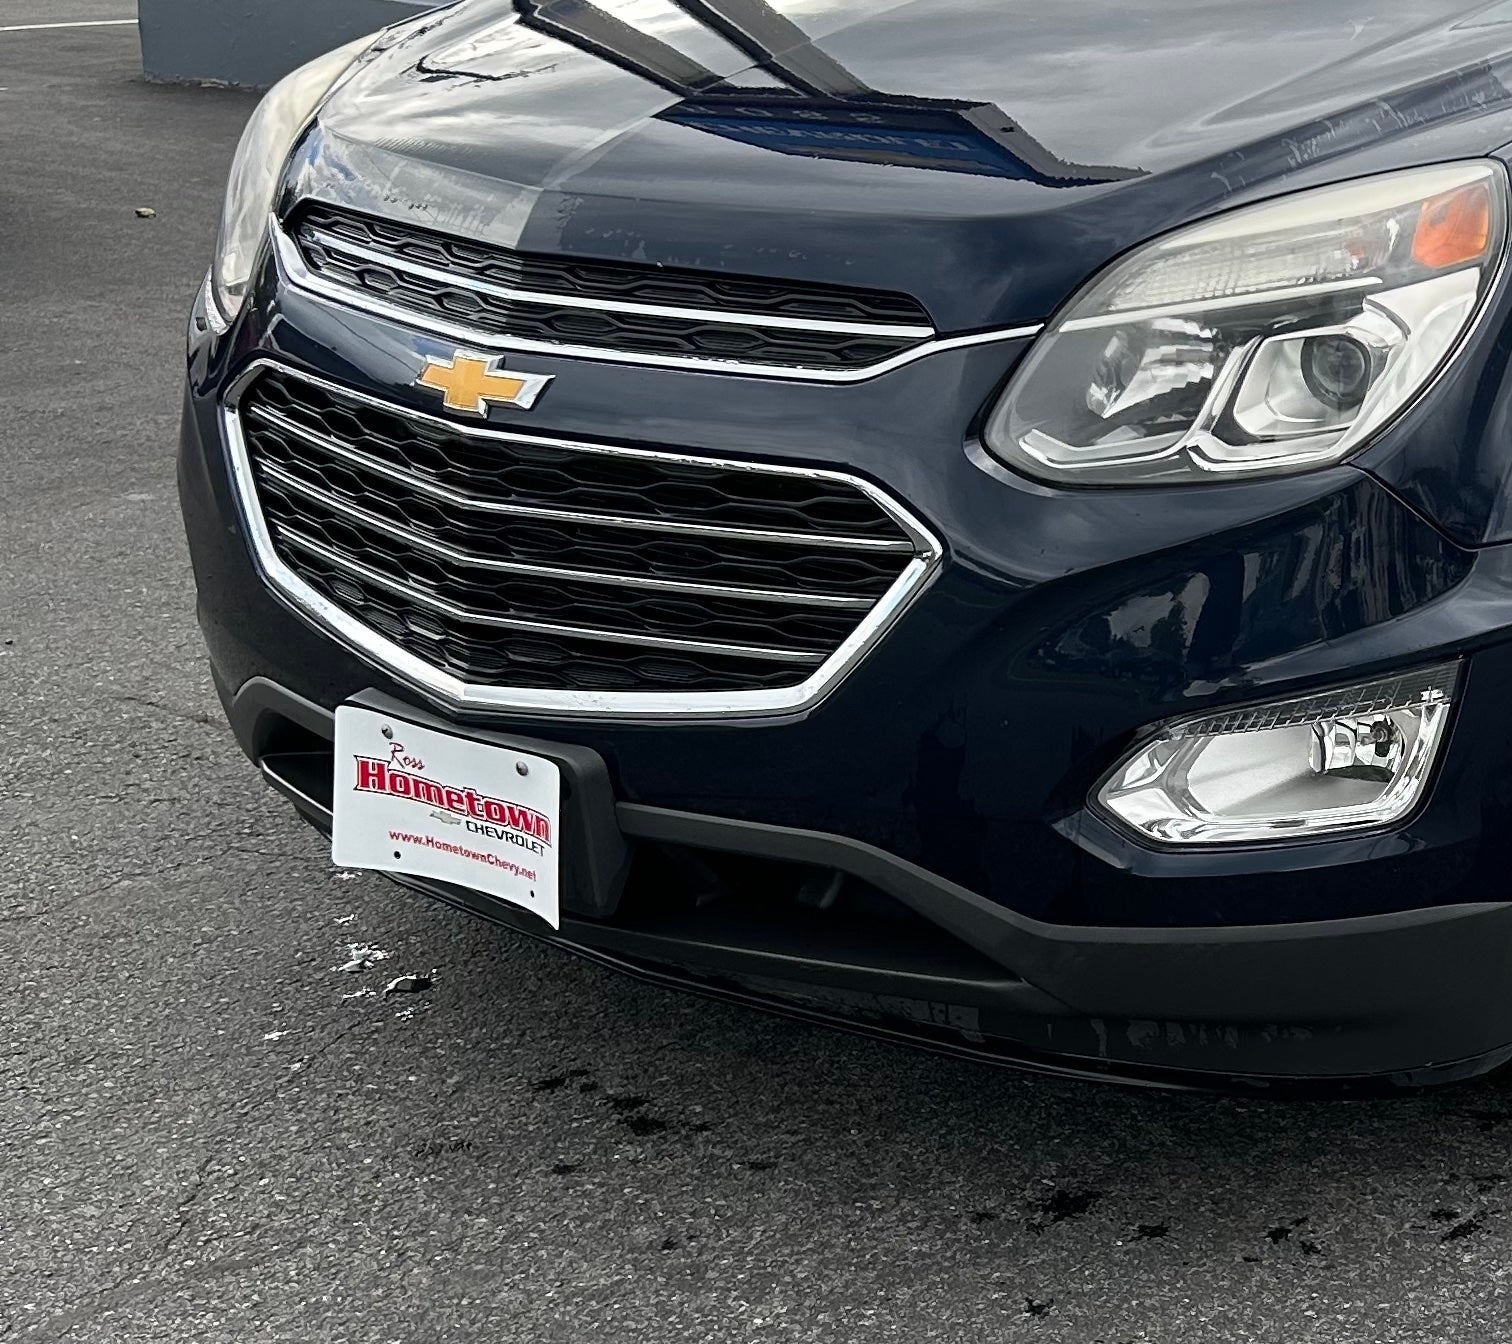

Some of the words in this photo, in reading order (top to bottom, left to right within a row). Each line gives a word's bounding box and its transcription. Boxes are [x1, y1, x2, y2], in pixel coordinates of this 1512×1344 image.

[389, 742, 425, 770] Ross
[355, 758, 550, 844] Hometown
[388, 830, 537, 882] www.HometownChevy.net
[466, 821, 545, 856] CHEVROLET
